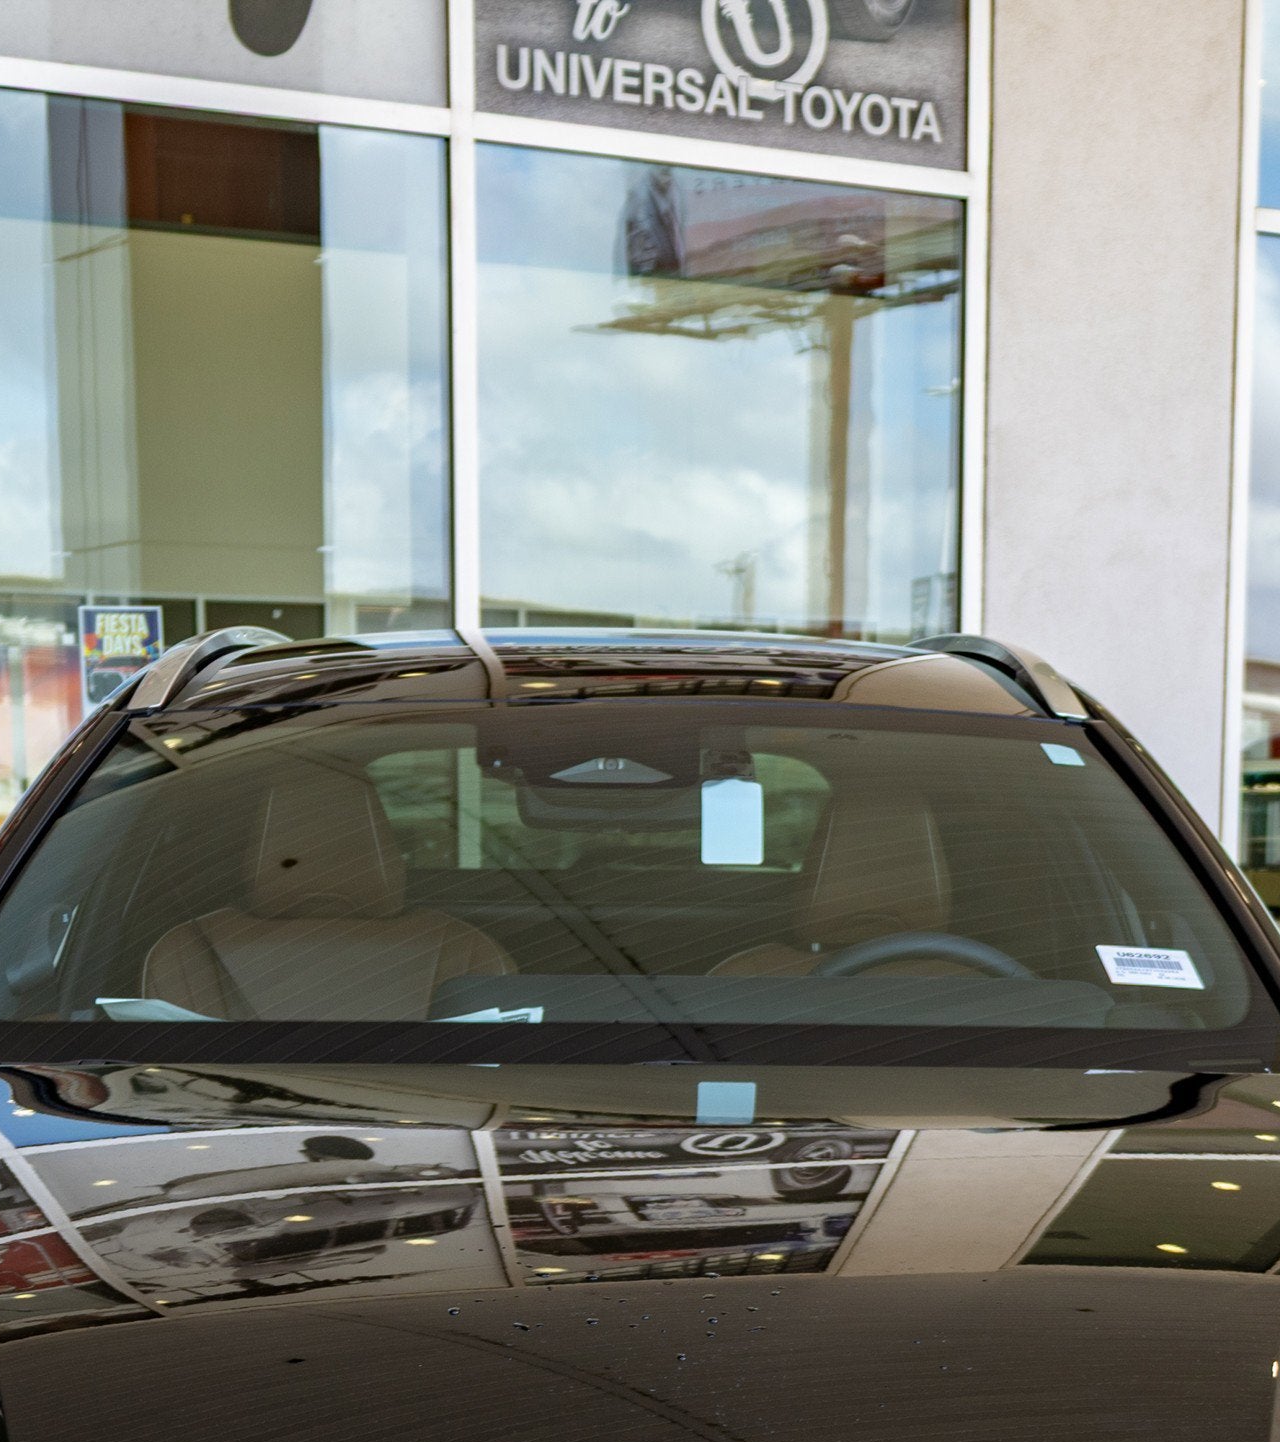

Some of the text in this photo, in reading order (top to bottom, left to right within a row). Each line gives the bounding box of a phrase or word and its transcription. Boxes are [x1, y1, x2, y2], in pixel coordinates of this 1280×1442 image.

[496, 44, 943, 144] UNIVERSAL TOYOTA
[95, 612, 149, 634] FIESTA
[103, 634, 142, 656] DAYS
